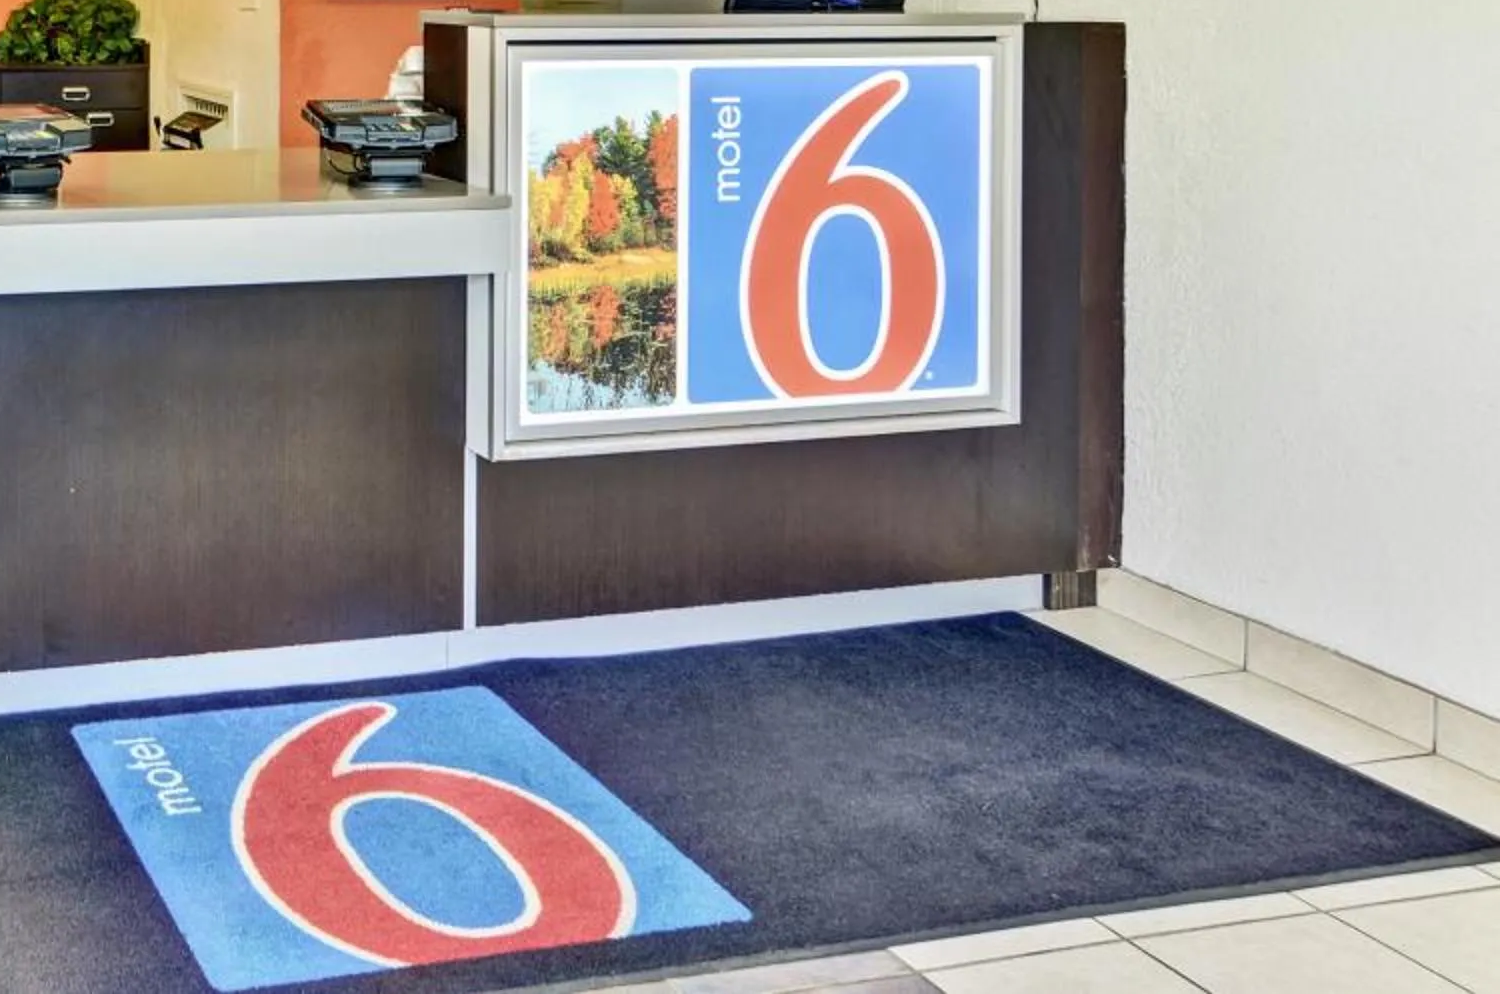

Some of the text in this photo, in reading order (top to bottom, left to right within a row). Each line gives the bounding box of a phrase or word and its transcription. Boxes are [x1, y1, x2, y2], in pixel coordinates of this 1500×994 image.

[710, 95, 742, 203] motel
[739, 69, 946, 400] 6
[113, 736, 202, 816] motel
[229, 700, 638, 969] 6
